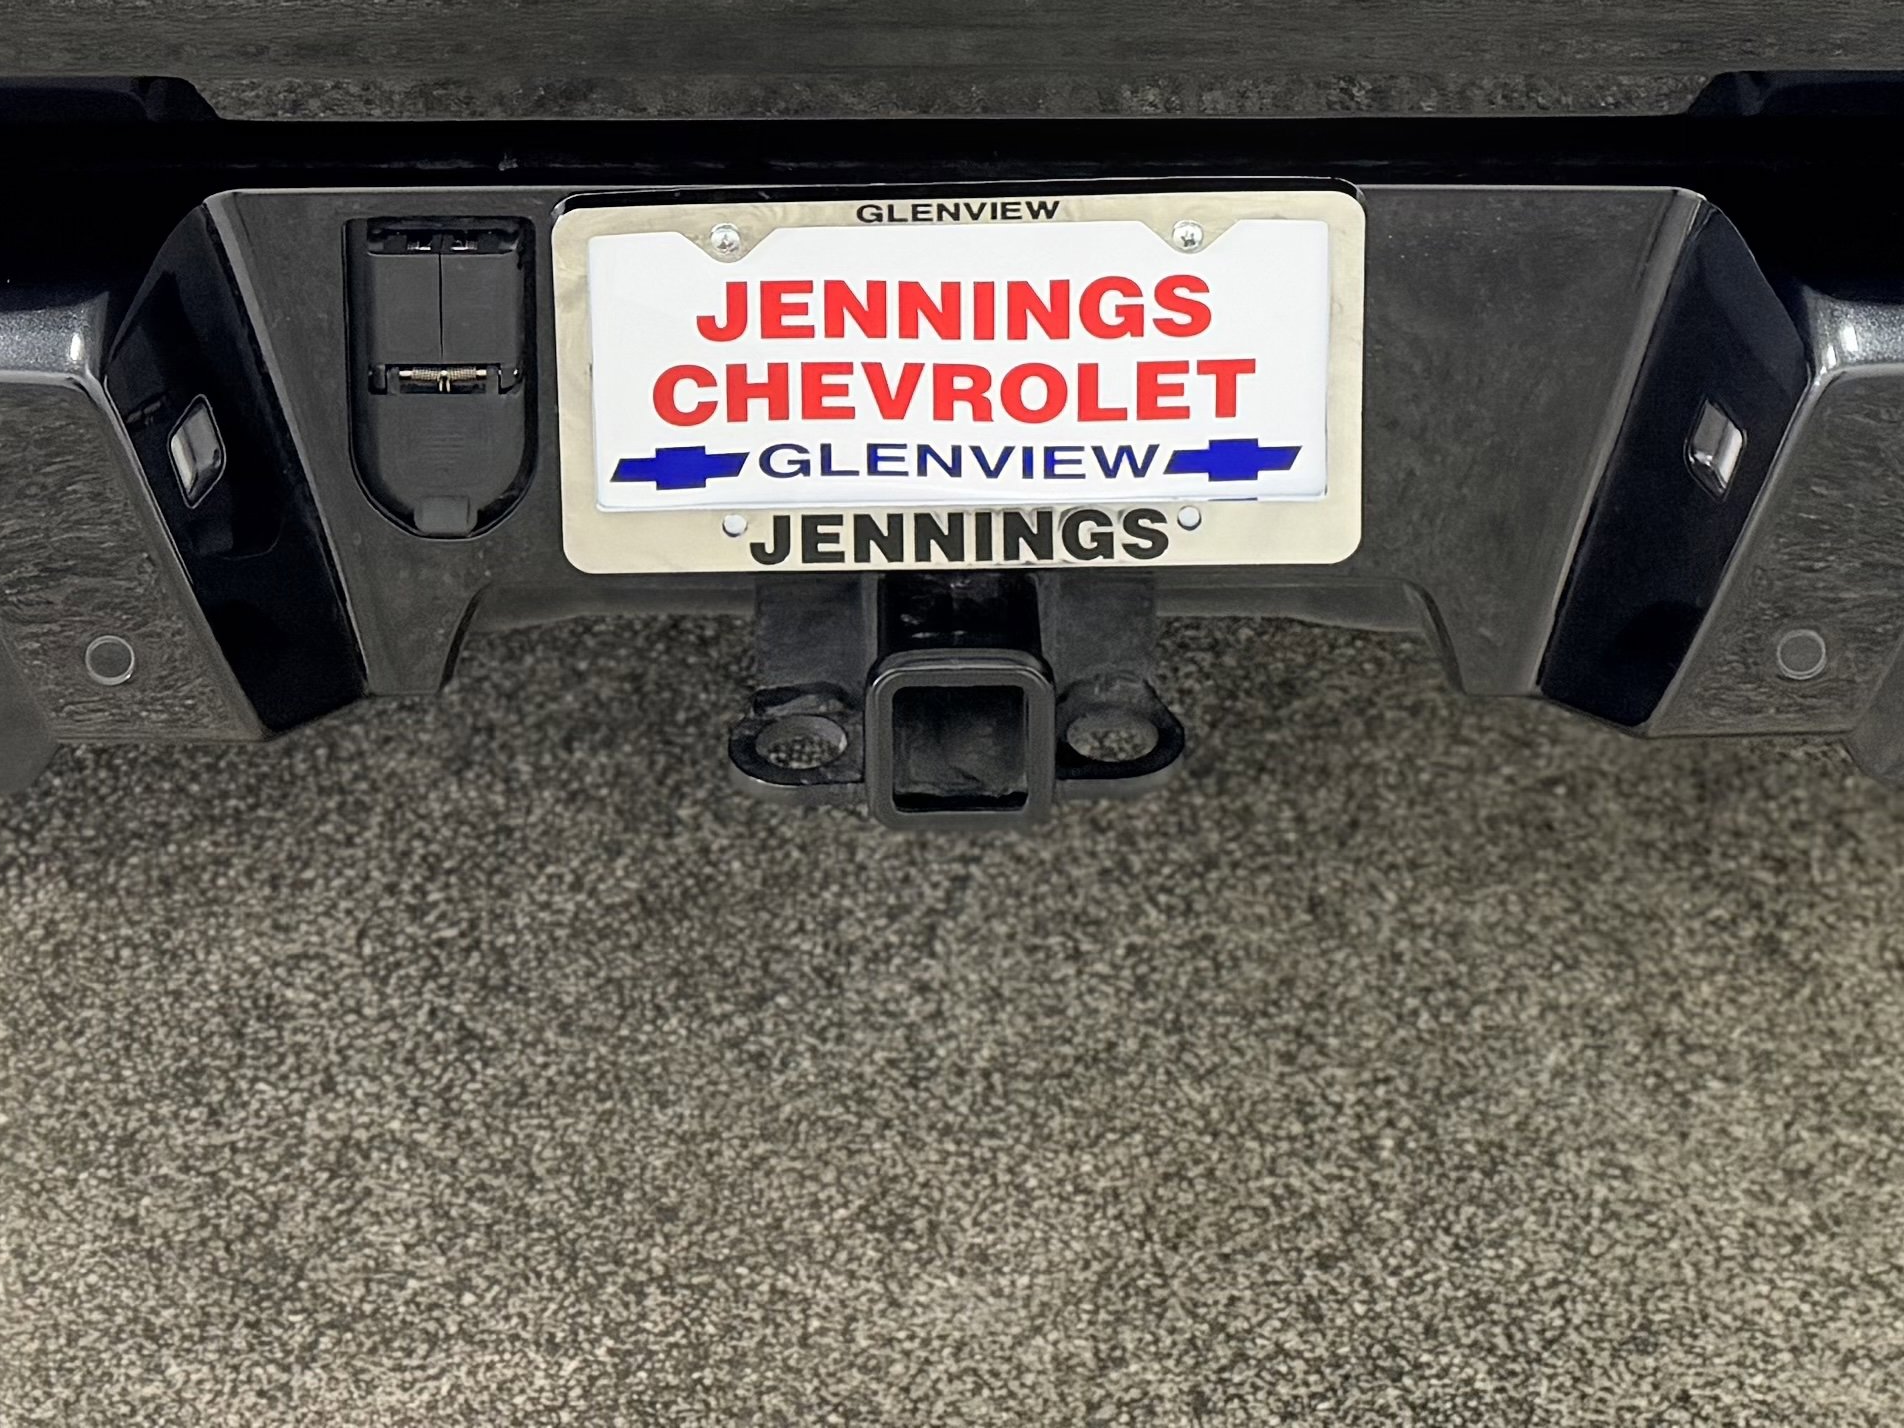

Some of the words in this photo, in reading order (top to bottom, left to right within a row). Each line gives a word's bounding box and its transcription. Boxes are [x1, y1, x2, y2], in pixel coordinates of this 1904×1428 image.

[855, 200, 1062, 224] GLENVIEW
[695, 274, 1213, 342] JENNINGS
[651, 358, 1257, 427] CHEVROLET
[759, 443, 1162, 480] GLENVIEW
[749, 507, 1170, 567] JENNINGS
